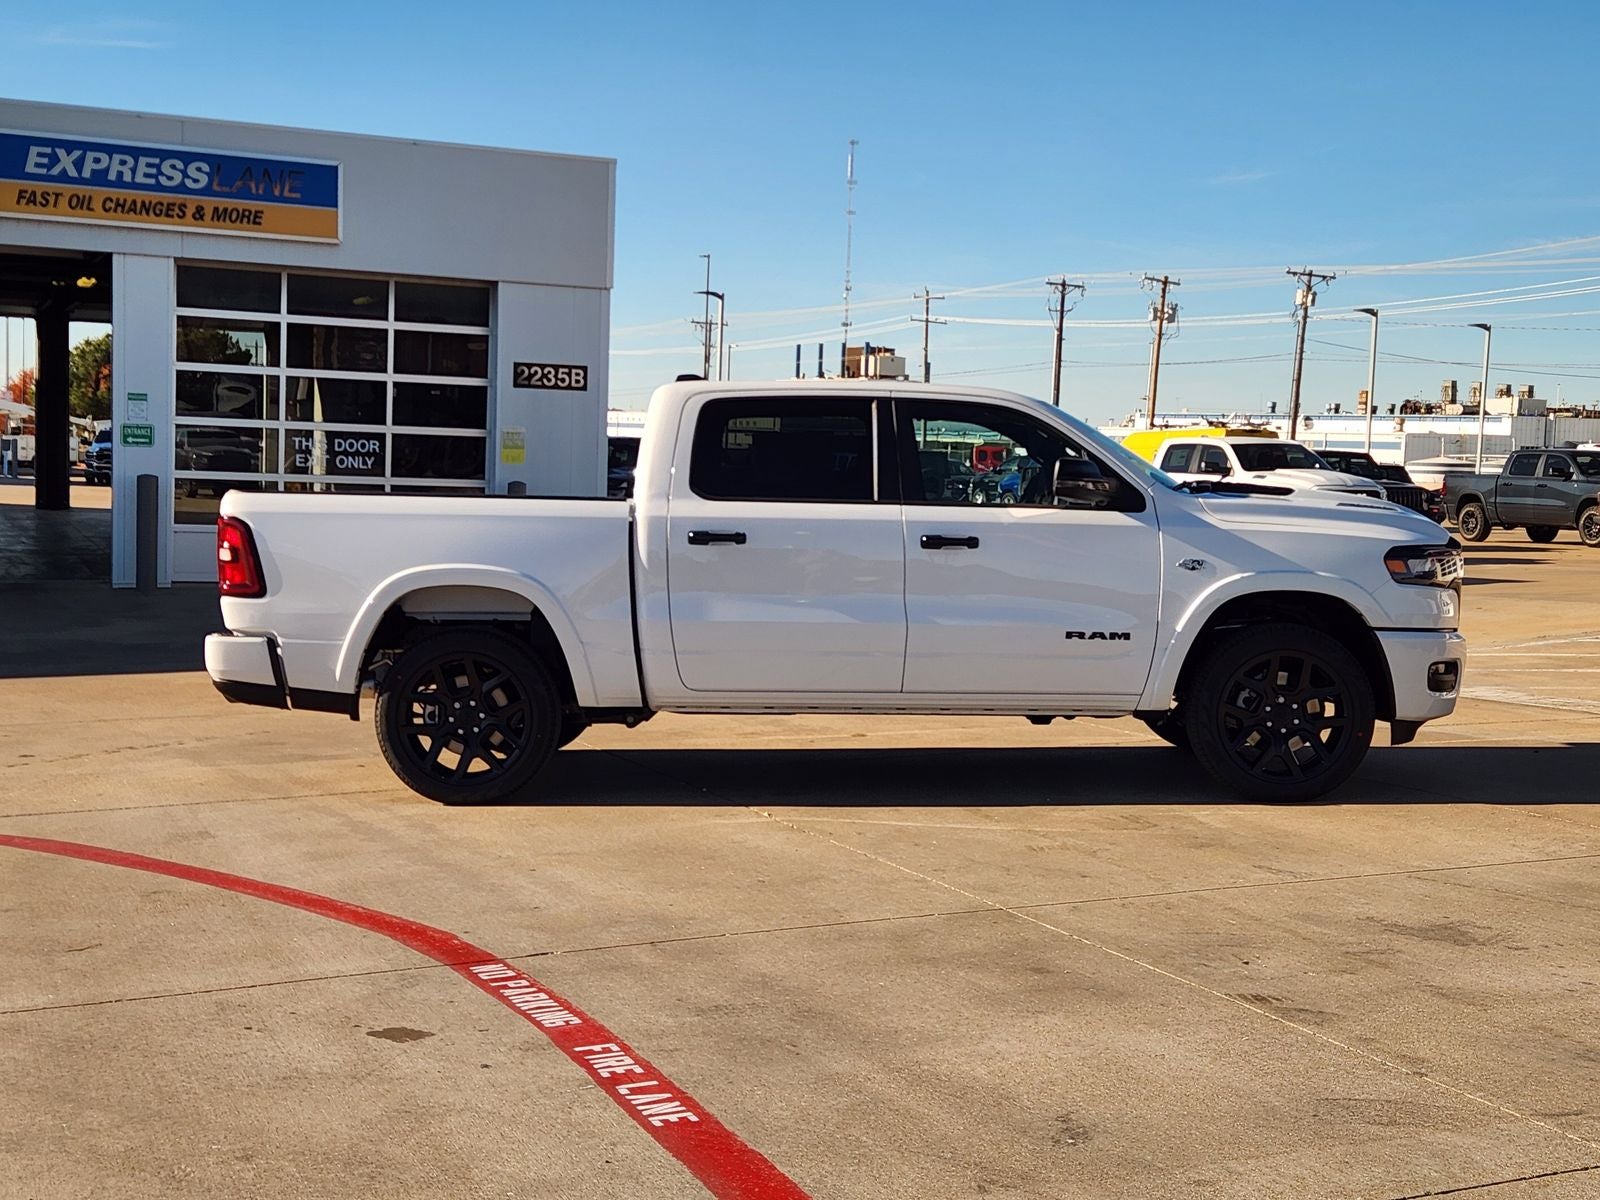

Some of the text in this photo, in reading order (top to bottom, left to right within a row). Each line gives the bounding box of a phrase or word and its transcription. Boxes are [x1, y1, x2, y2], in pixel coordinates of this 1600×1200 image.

[24, 145, 210, 190] EXPRESS
[15, 189, 264, 225] FAST OIL CHANGES & MORE
[516, 366, 585, 388] 2235B
[291, 437, 380, 453] THS DOOR
[295, 454, 375, 469] EXT ONLY
[1065, 631, 1131, 640] RAM
[469, 963, 583, 1028] NO PARKING
[573, 1043, 699, 1127] FIRE LANE
